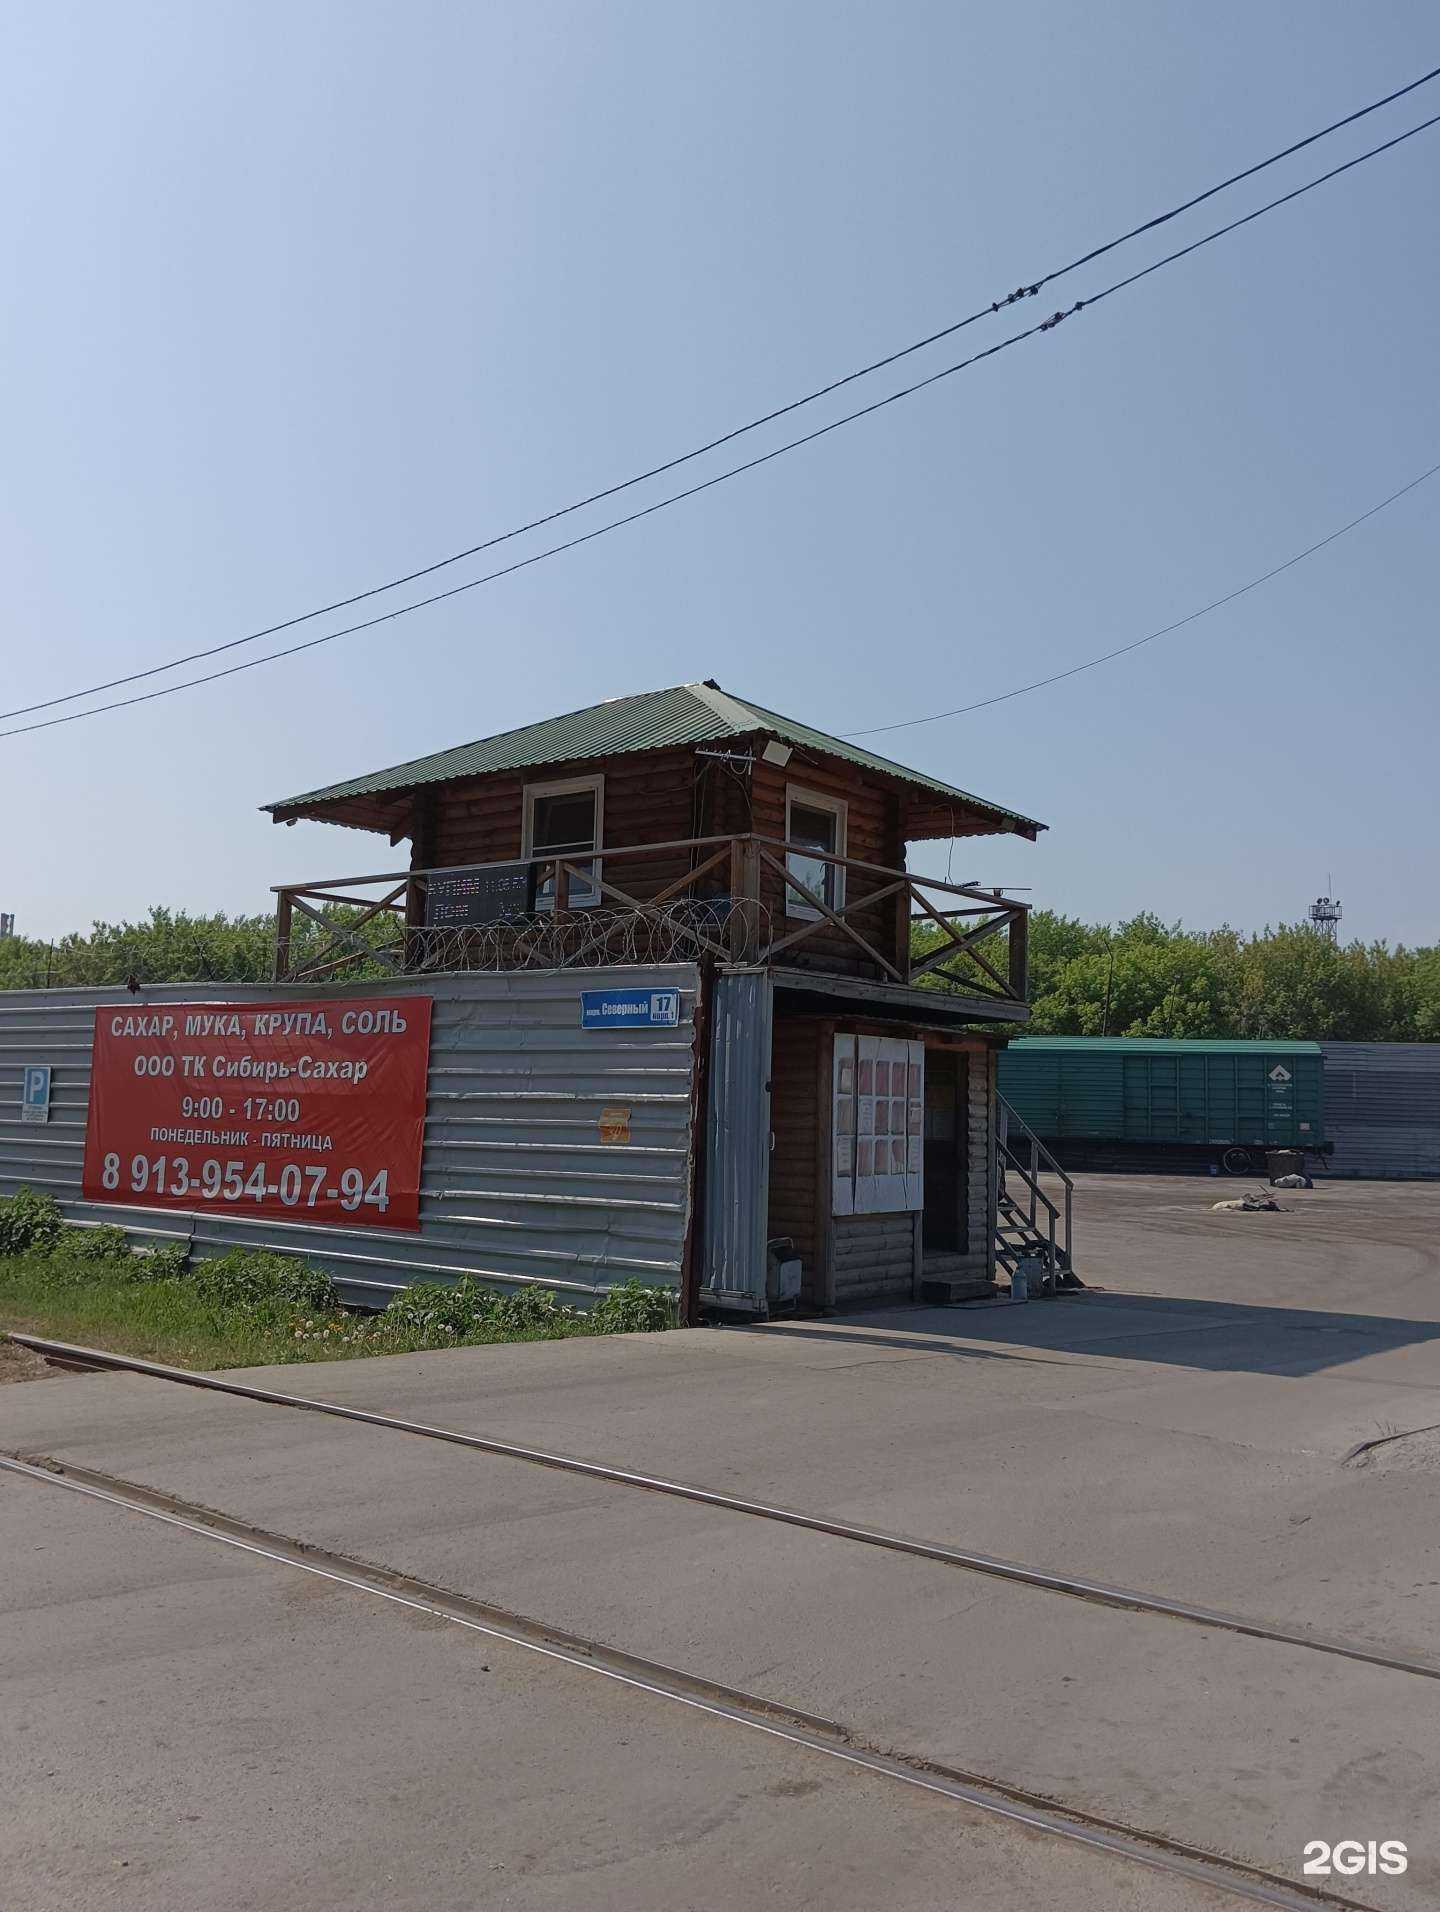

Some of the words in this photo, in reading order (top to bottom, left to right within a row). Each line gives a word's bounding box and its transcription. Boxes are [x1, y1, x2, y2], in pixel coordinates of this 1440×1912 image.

[602, 1001, 649, 1015] Северный
[656, 997, 671, 1012] 17
[111, 1016, 178, 1040] САХАР,
[185, 1014, 246, 1040] МУКА,
[254, 1012, 333, 1039] КРУПА,
[342, 1010, 407, 1034] СОЛЬ
[134, 1055, 175, 1076] ООО
[182, 1056, 207, 1077] ТК
[212, 1056, 368, 1084] Сибирь-Сахар
[182, 1096, 223, 1119] 9:00
[243, 1098, 300, 1121] 17:00
[150, 1127, 249, 1146] ПОНЕДЕЛЬНИК
[261, 1132, 333, 1153] ПЯТНИЦА
[102, 1152, 120, 1190] 8
[130, 1153, 390, 1213] 913-954-07-94
